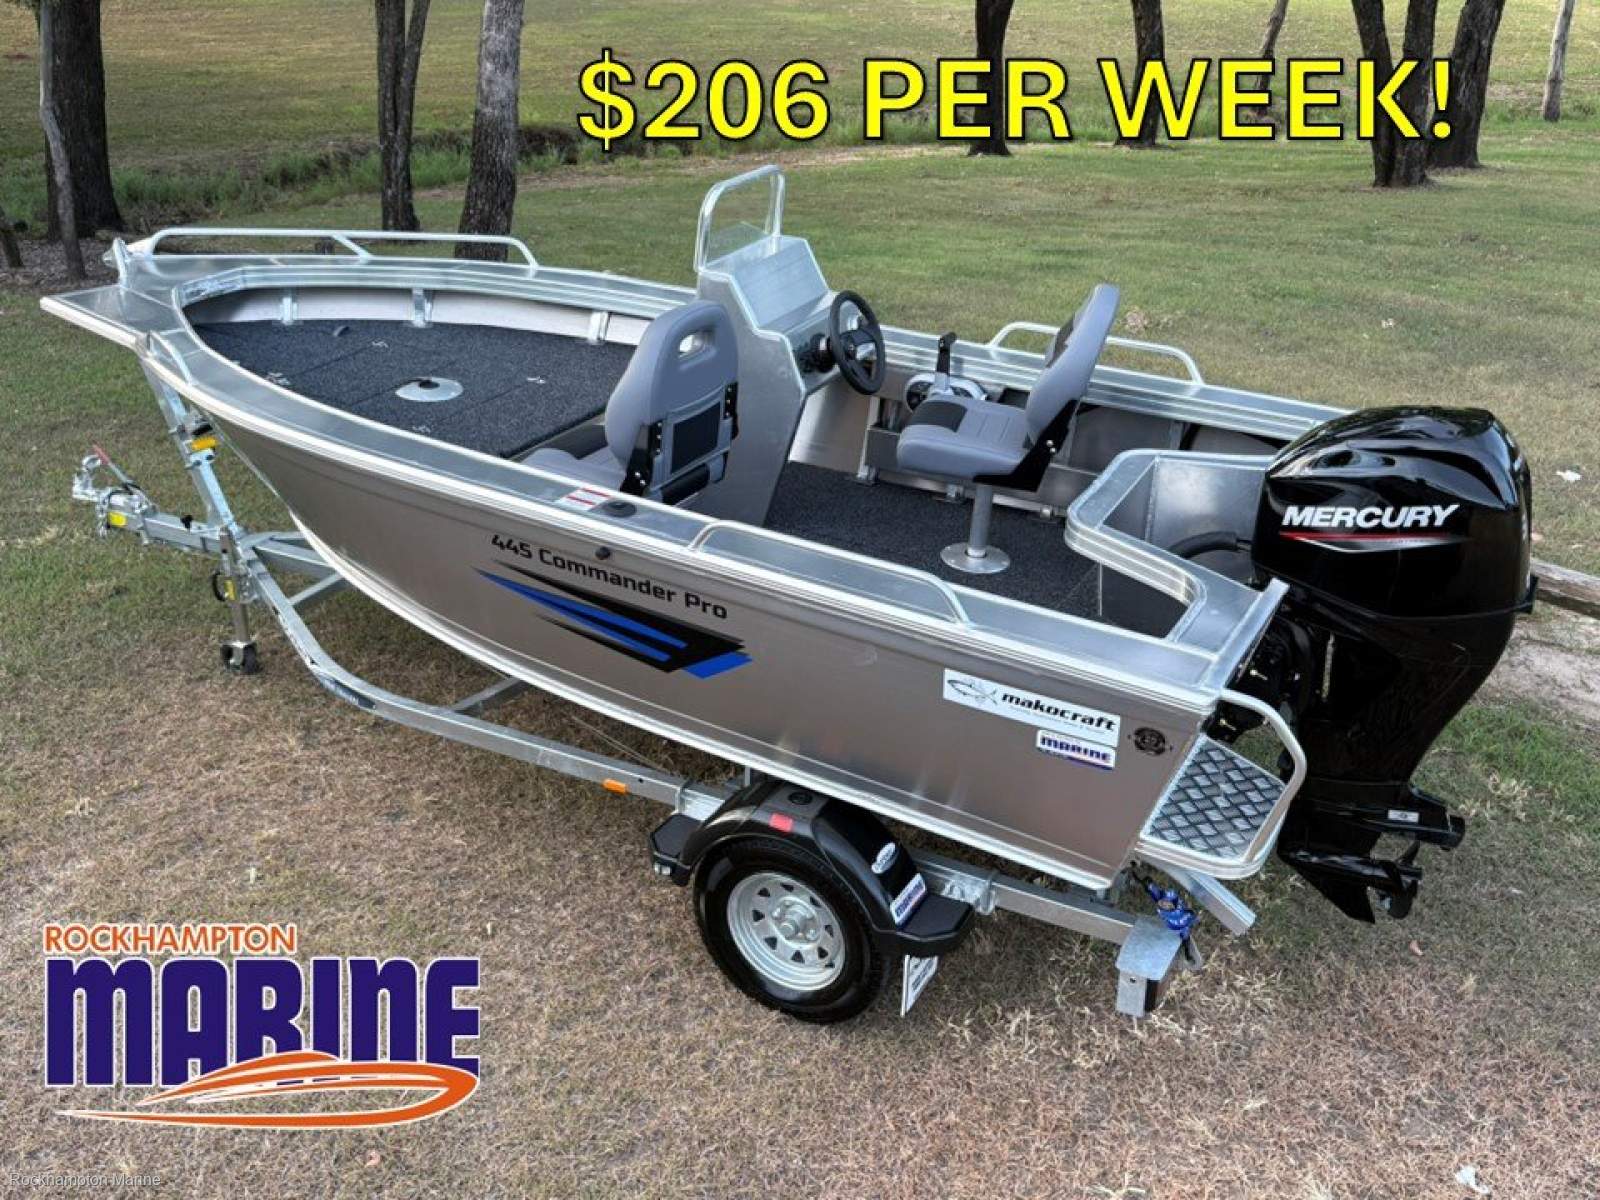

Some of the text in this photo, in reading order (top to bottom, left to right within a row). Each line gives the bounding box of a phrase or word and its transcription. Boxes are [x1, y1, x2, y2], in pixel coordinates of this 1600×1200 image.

[1282, 504, 1460, 528] MERCURY
[491, 534, 728, 619] 445 Commander Pro
[1002, 692, 1117, 731] makocraft
